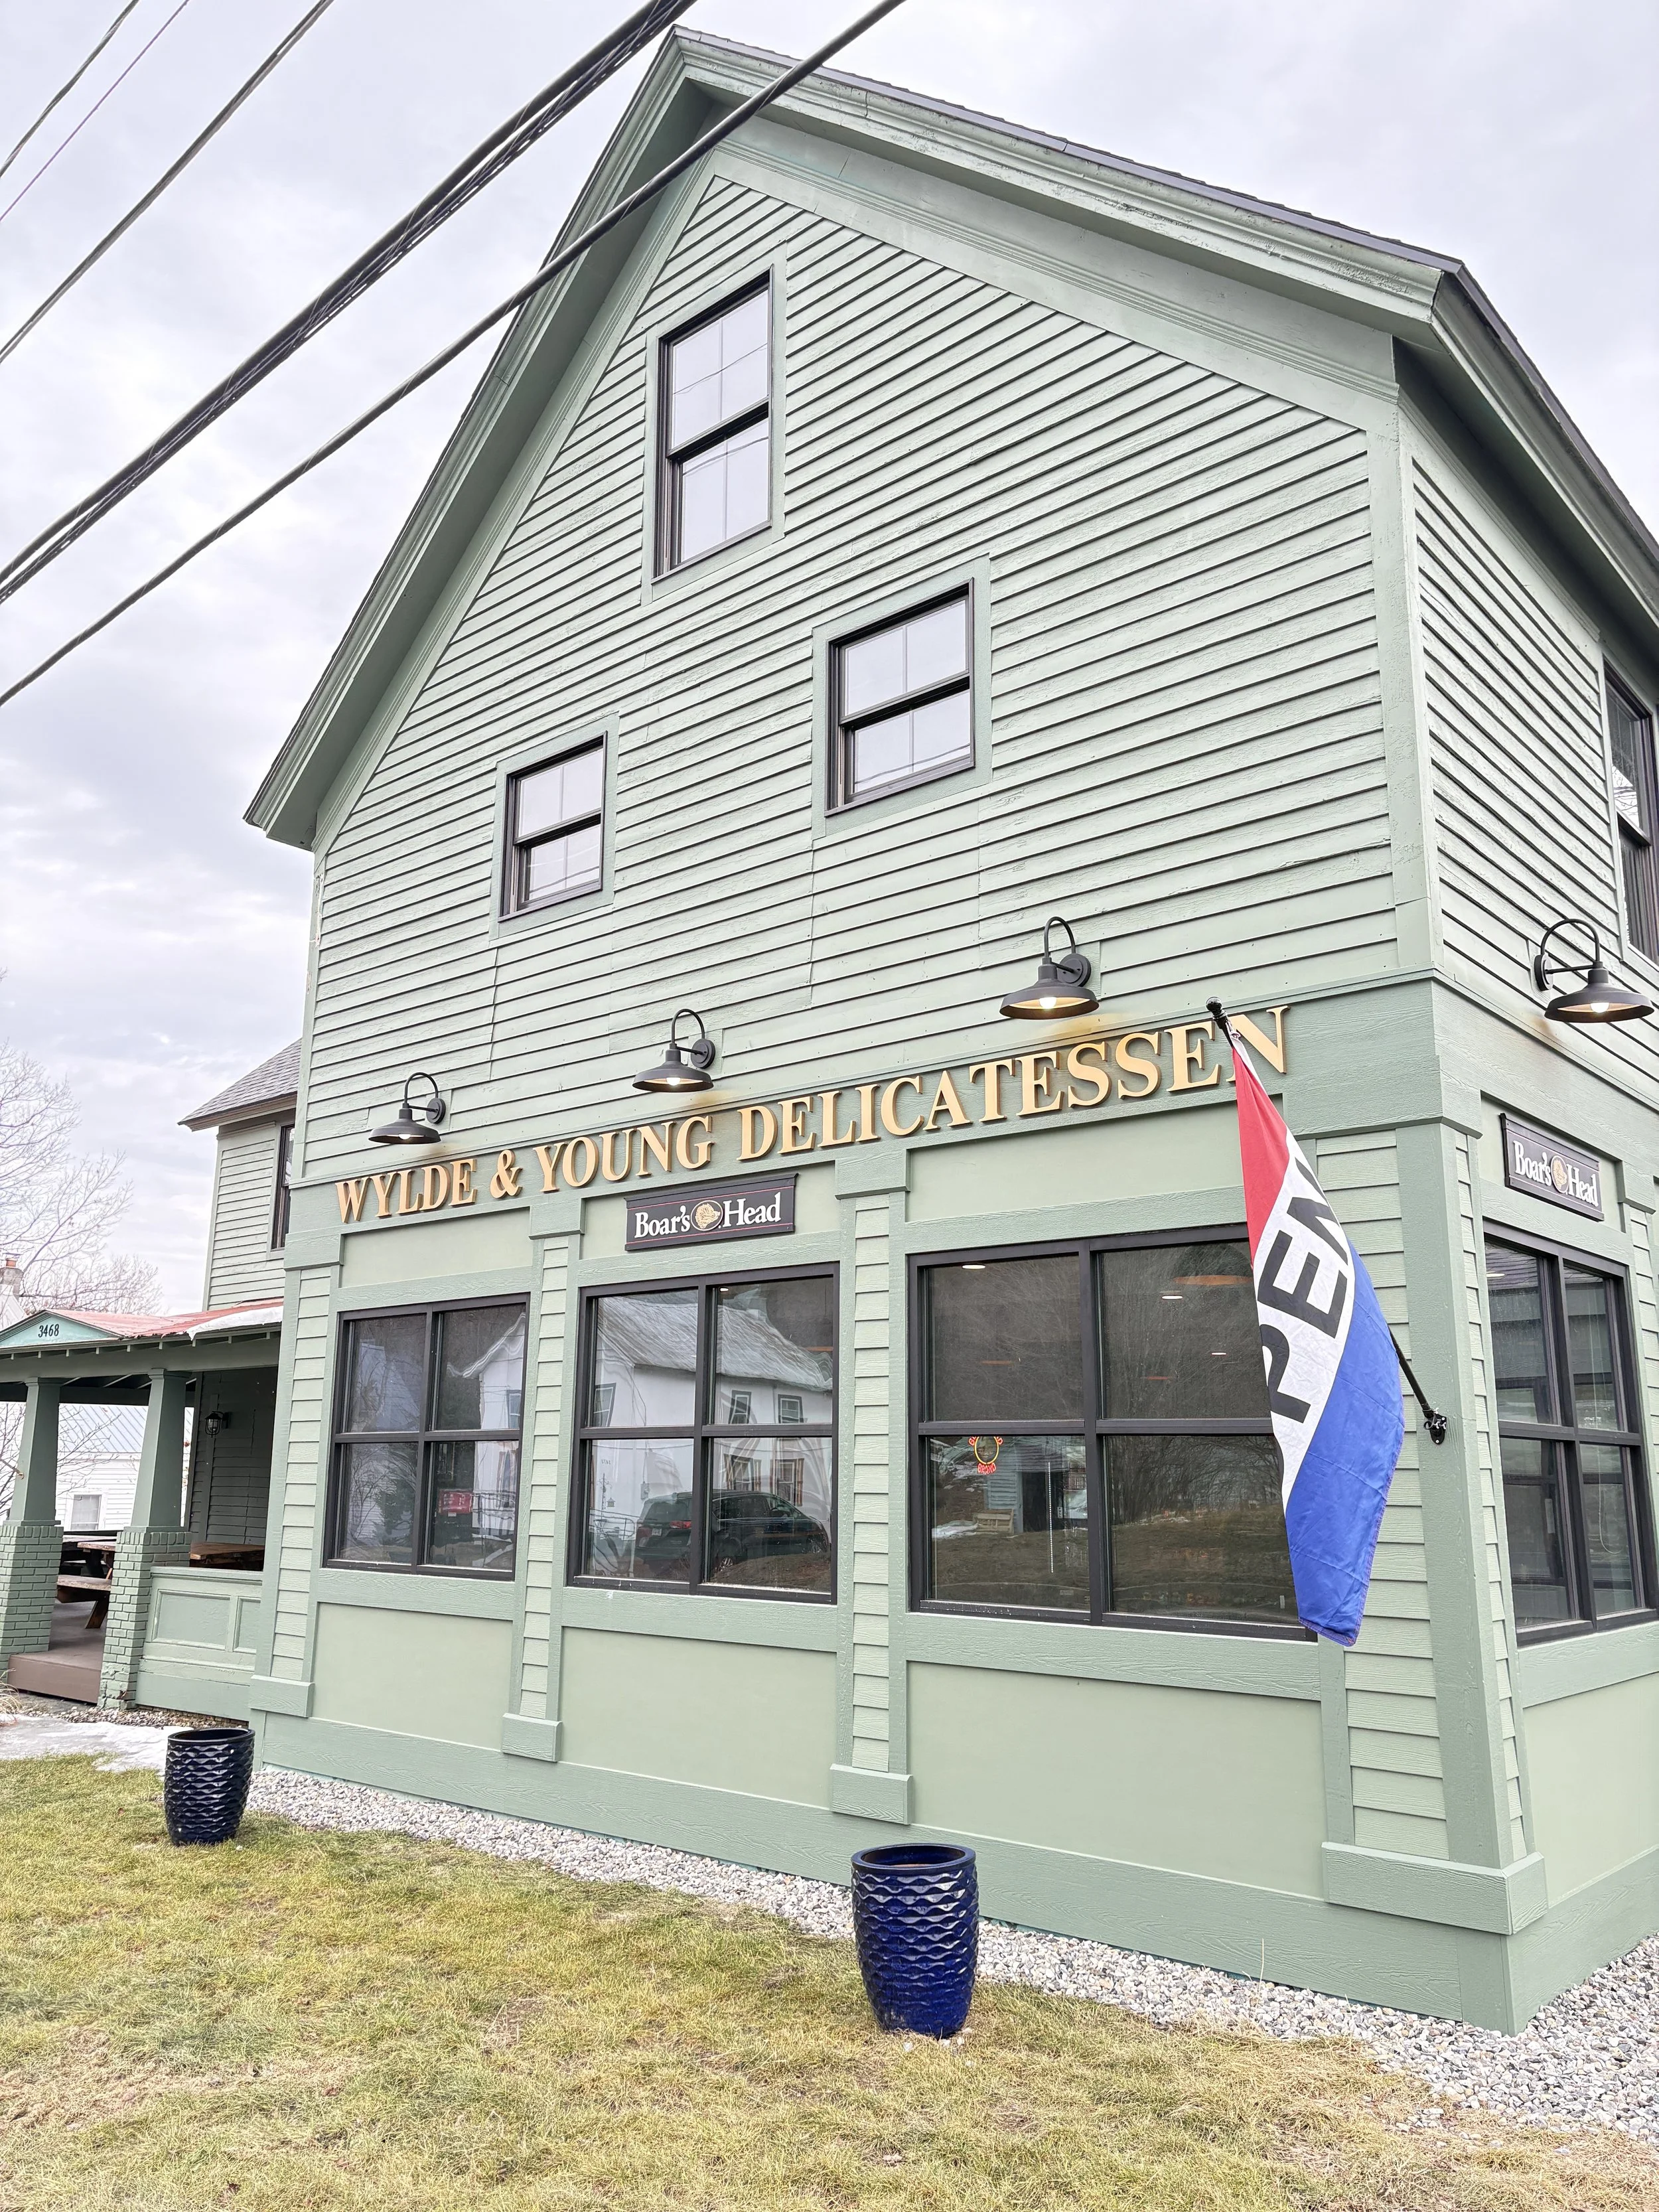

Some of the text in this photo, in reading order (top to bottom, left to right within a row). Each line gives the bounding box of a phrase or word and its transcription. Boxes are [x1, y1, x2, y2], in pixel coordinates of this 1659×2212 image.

[334, 1005, 1291, 1224] WYLDE & YOUNG DELICATESSEN
[1512, 1140, 1599, 1207] Boar's Head
[634, 1191, 782, 1239] Boar's Head
[1257, 1156, 1348, 1424] PEN
[38, 1323, 60, 1338] 3468
[977, 1462, 997, 1475] BRAND
